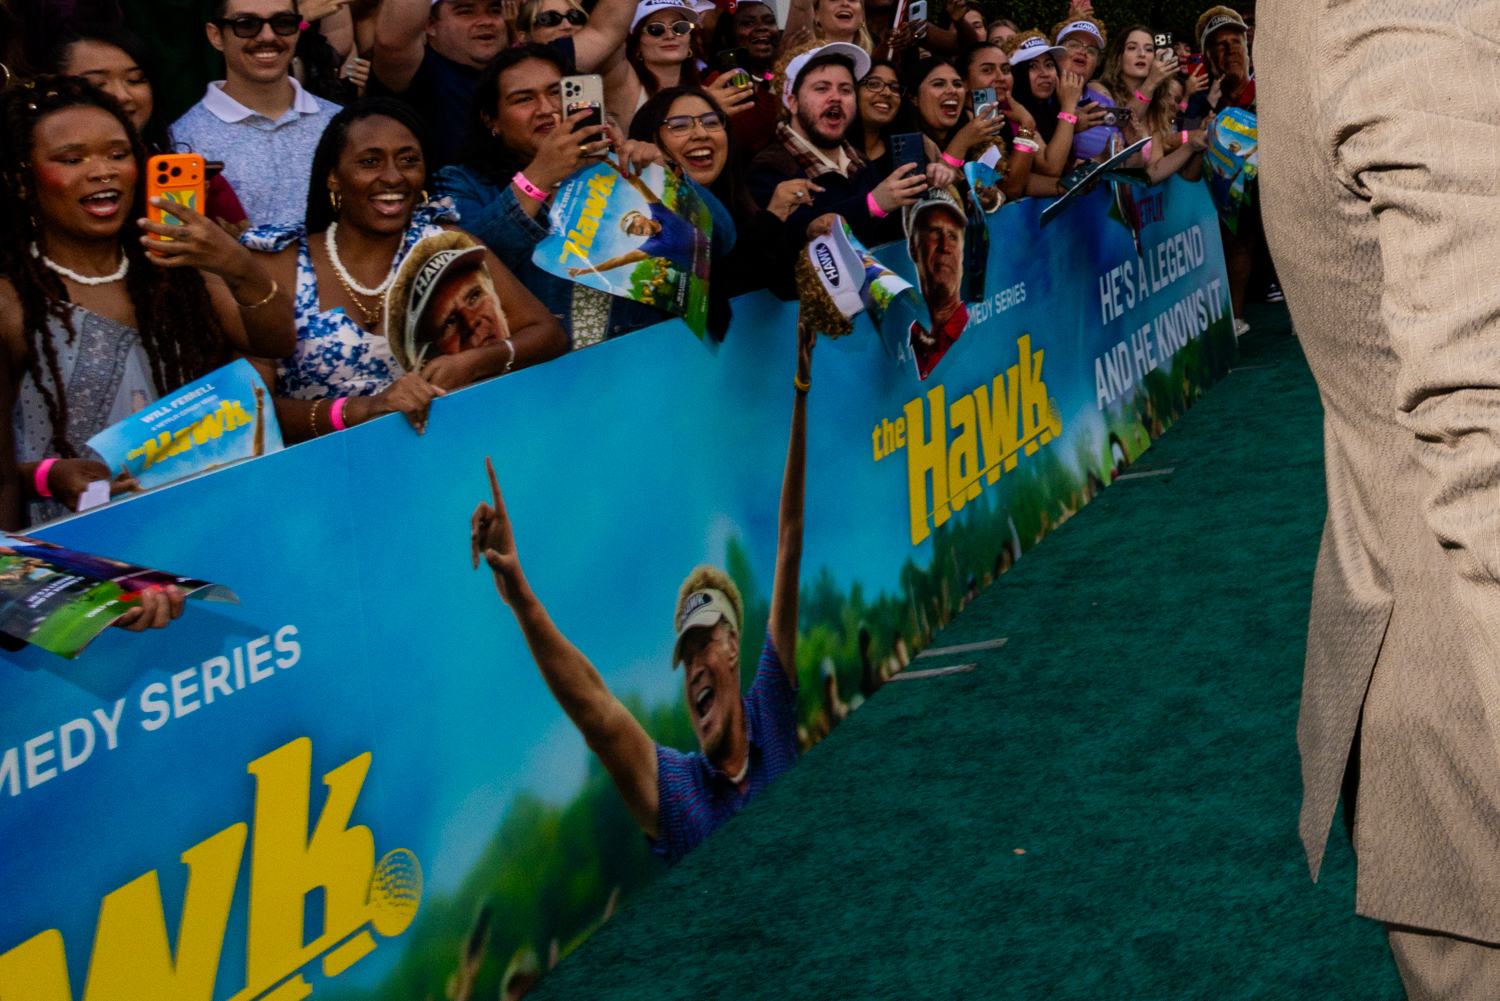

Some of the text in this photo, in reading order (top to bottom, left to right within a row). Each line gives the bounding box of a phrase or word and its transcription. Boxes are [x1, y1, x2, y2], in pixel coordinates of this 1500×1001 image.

[563, 172, 617, 259] Hawk
[1135, 192, 1164, 230] ETFLIX
[816, 245, 839, 280] HAWK
[995, 281, 1027, 318] SERIES
[1099, 225, 1204, 325] HE'S A LEGEND
[1095, 278, 1223, 411] AND HE KNOWS IT
[141, 383, 215, 424] WILL FERRELL
[142, 399, 252, 471] Hawk
[871, 333, 1052, 547] the Hawk
[139, 624, 303, 731] SERIES
